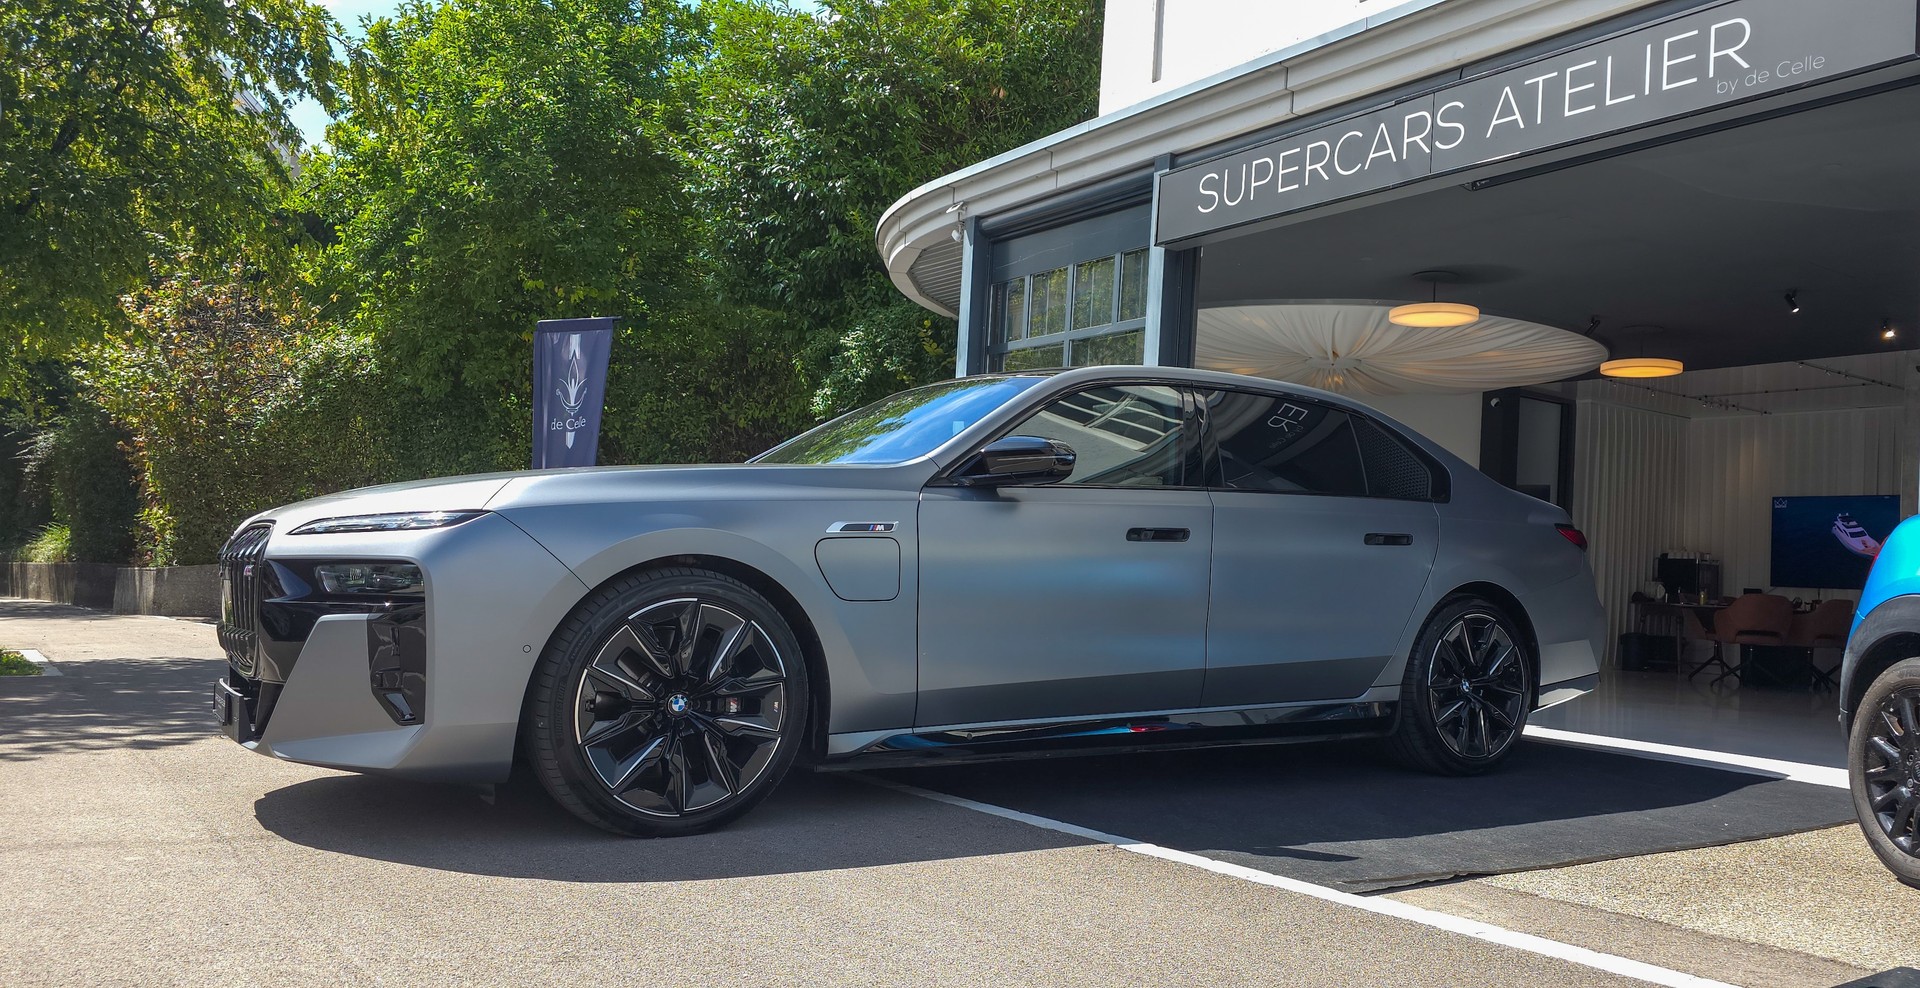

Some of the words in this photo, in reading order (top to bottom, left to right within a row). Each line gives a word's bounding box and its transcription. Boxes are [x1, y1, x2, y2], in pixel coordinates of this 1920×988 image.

[1716, 79, 1739, 95] by
[1744, 69, 1770, 87] de
[1776, 55, 1825, 78] Celle
[1197, 101, 1465, 213] SUPERCARS
[1486, 17, 1751, 138] ATELIER
[551, 418, 563, 430] de
